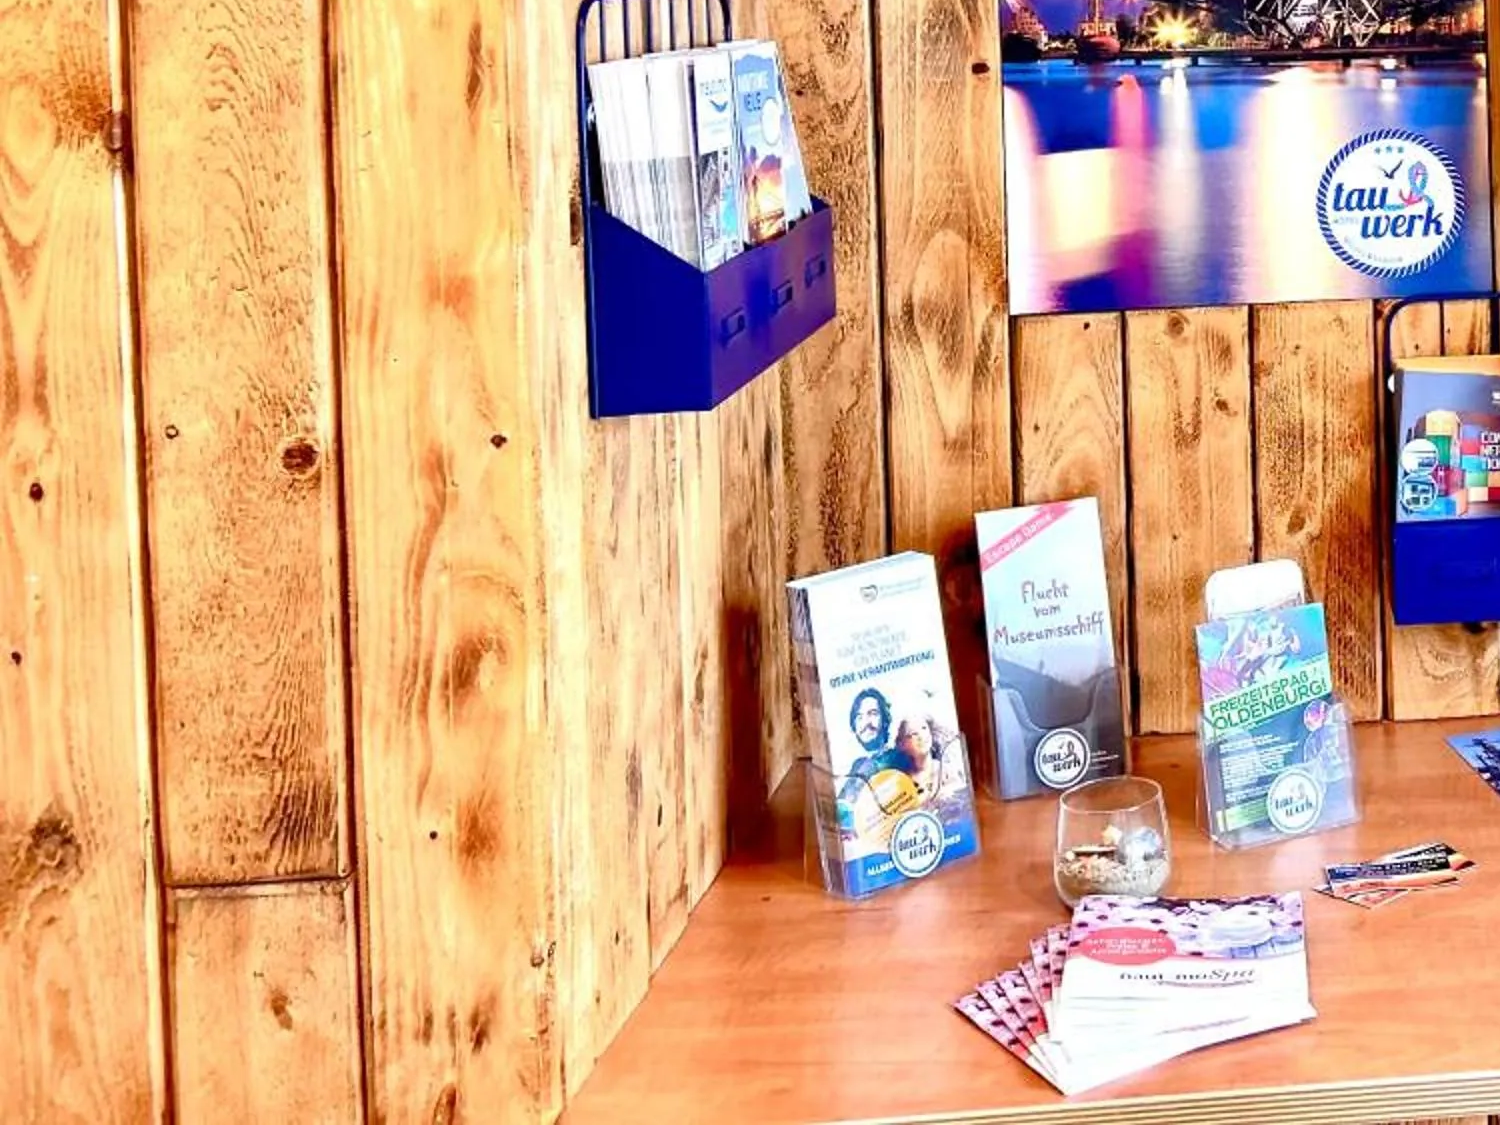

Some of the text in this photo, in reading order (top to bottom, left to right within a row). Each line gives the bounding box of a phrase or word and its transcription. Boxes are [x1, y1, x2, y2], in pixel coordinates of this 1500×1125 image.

[1332, 182, 1388, 212] tau
[1360, 205, 1444, 239] werk
[1022, 579, 1069, 603] Flucht
[1034, 605, 1061, 618] vom
[994, 611, 1104, 645] Museumsschiff
[1212, 678, 1327, 730] OLDENBURG!
